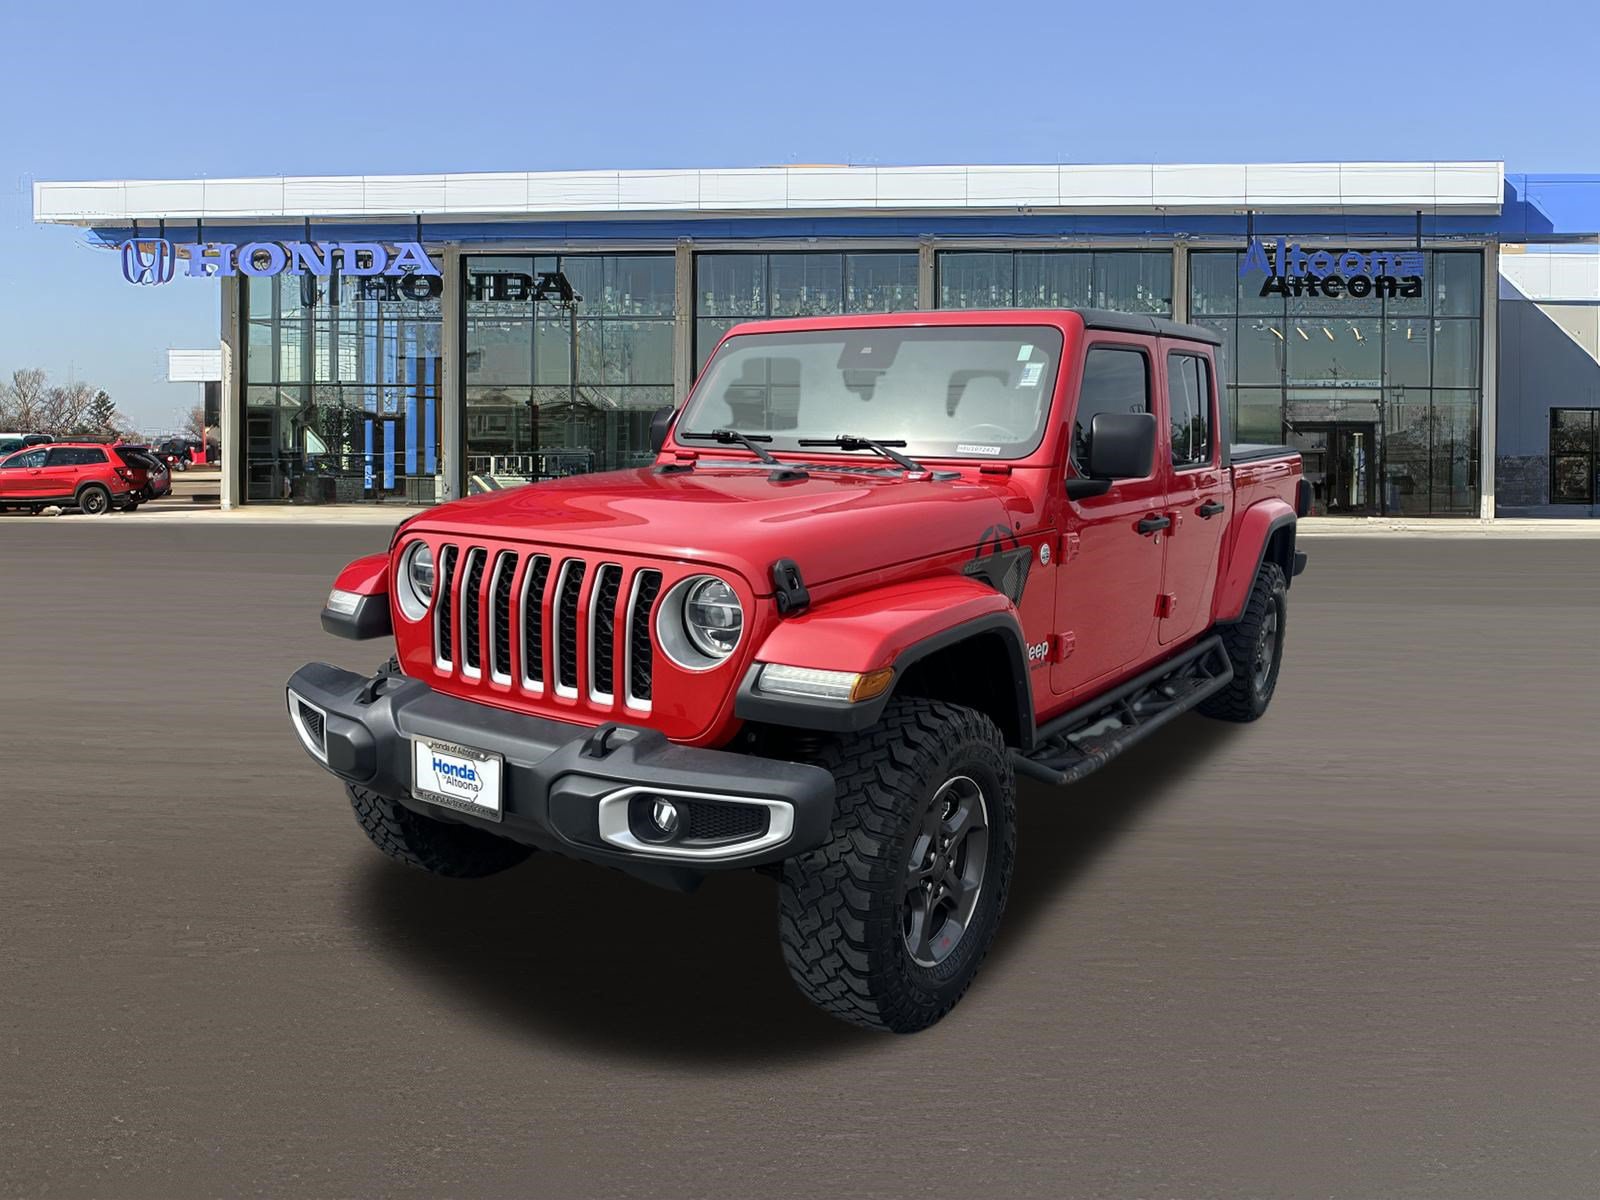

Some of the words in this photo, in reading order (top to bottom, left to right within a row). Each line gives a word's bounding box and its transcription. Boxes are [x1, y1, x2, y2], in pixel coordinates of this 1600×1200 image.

[186, 242, 441, 277] HONDA
[432, 756, 476, 782] Honda
[446, 775, 479, 793] Altoona
